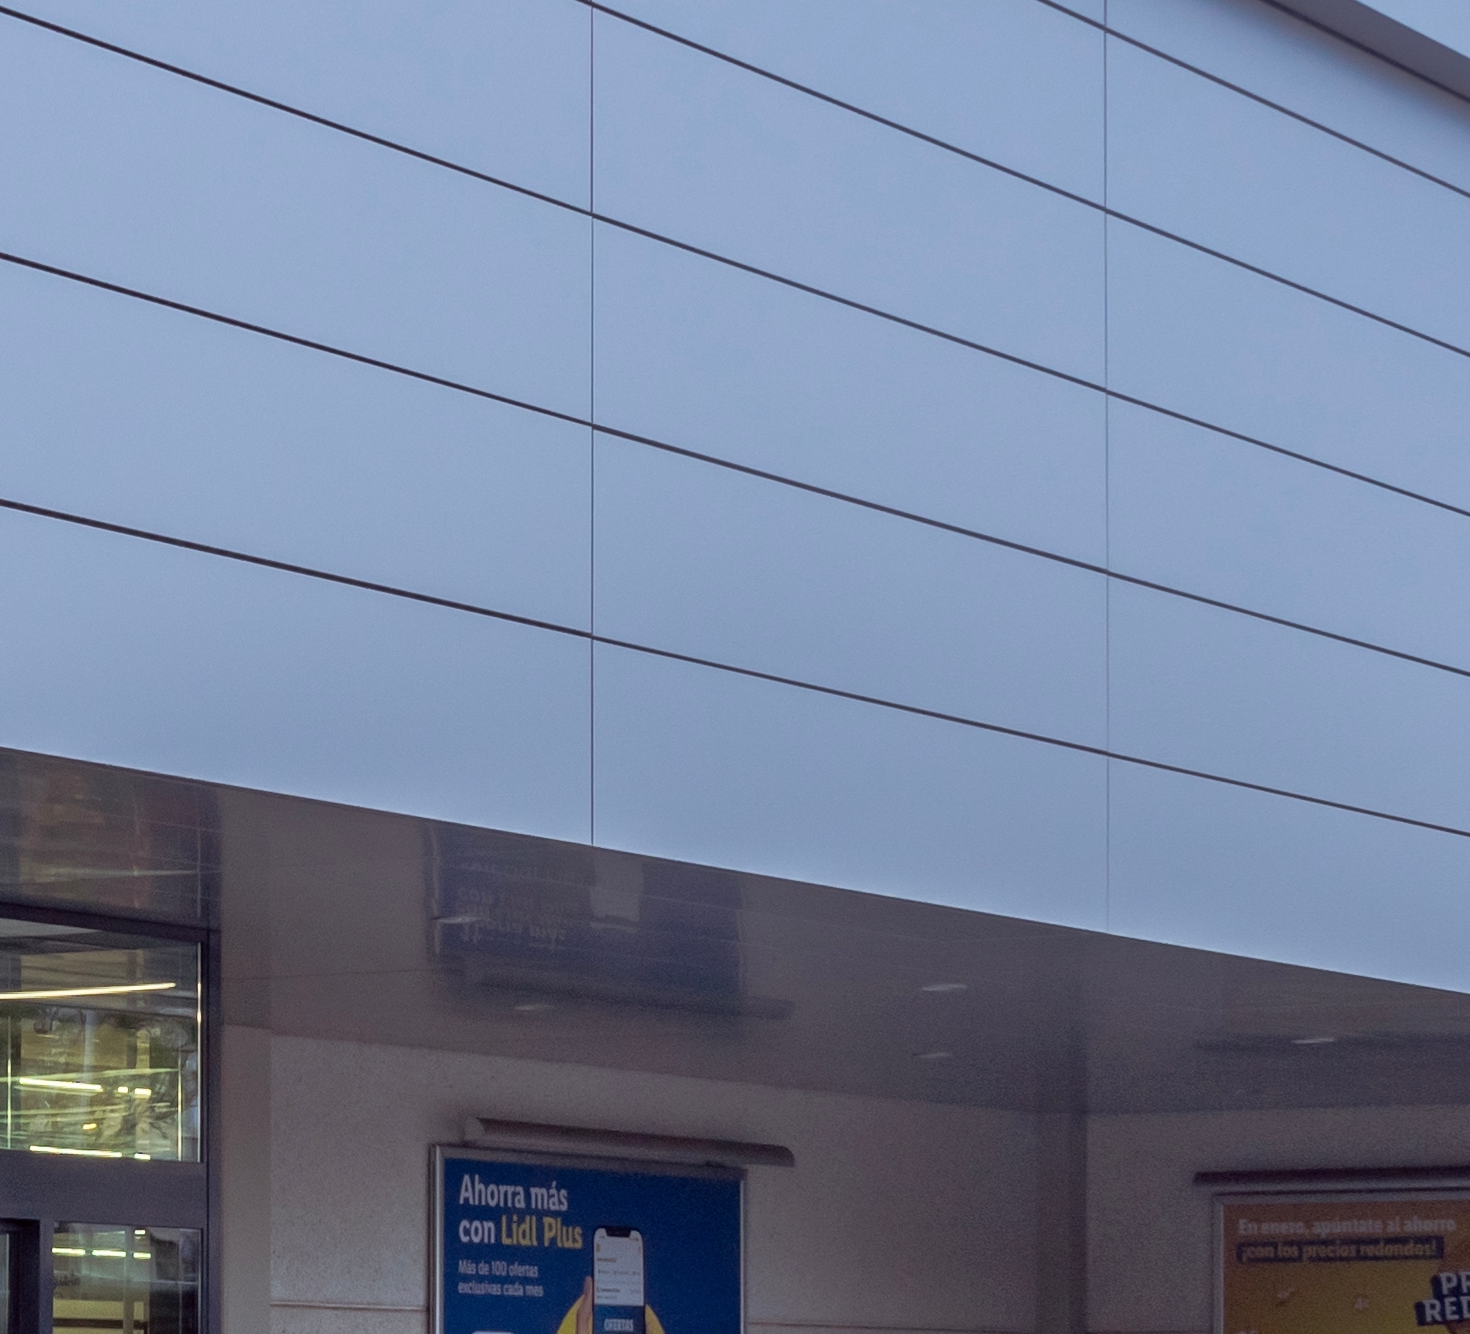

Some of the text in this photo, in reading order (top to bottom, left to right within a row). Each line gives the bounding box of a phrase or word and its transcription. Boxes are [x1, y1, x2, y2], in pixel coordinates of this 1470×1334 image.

[459, 1173, 568, 1211] Ahorra más
[458, 1214, 583, 1249] con Lidl Plus
